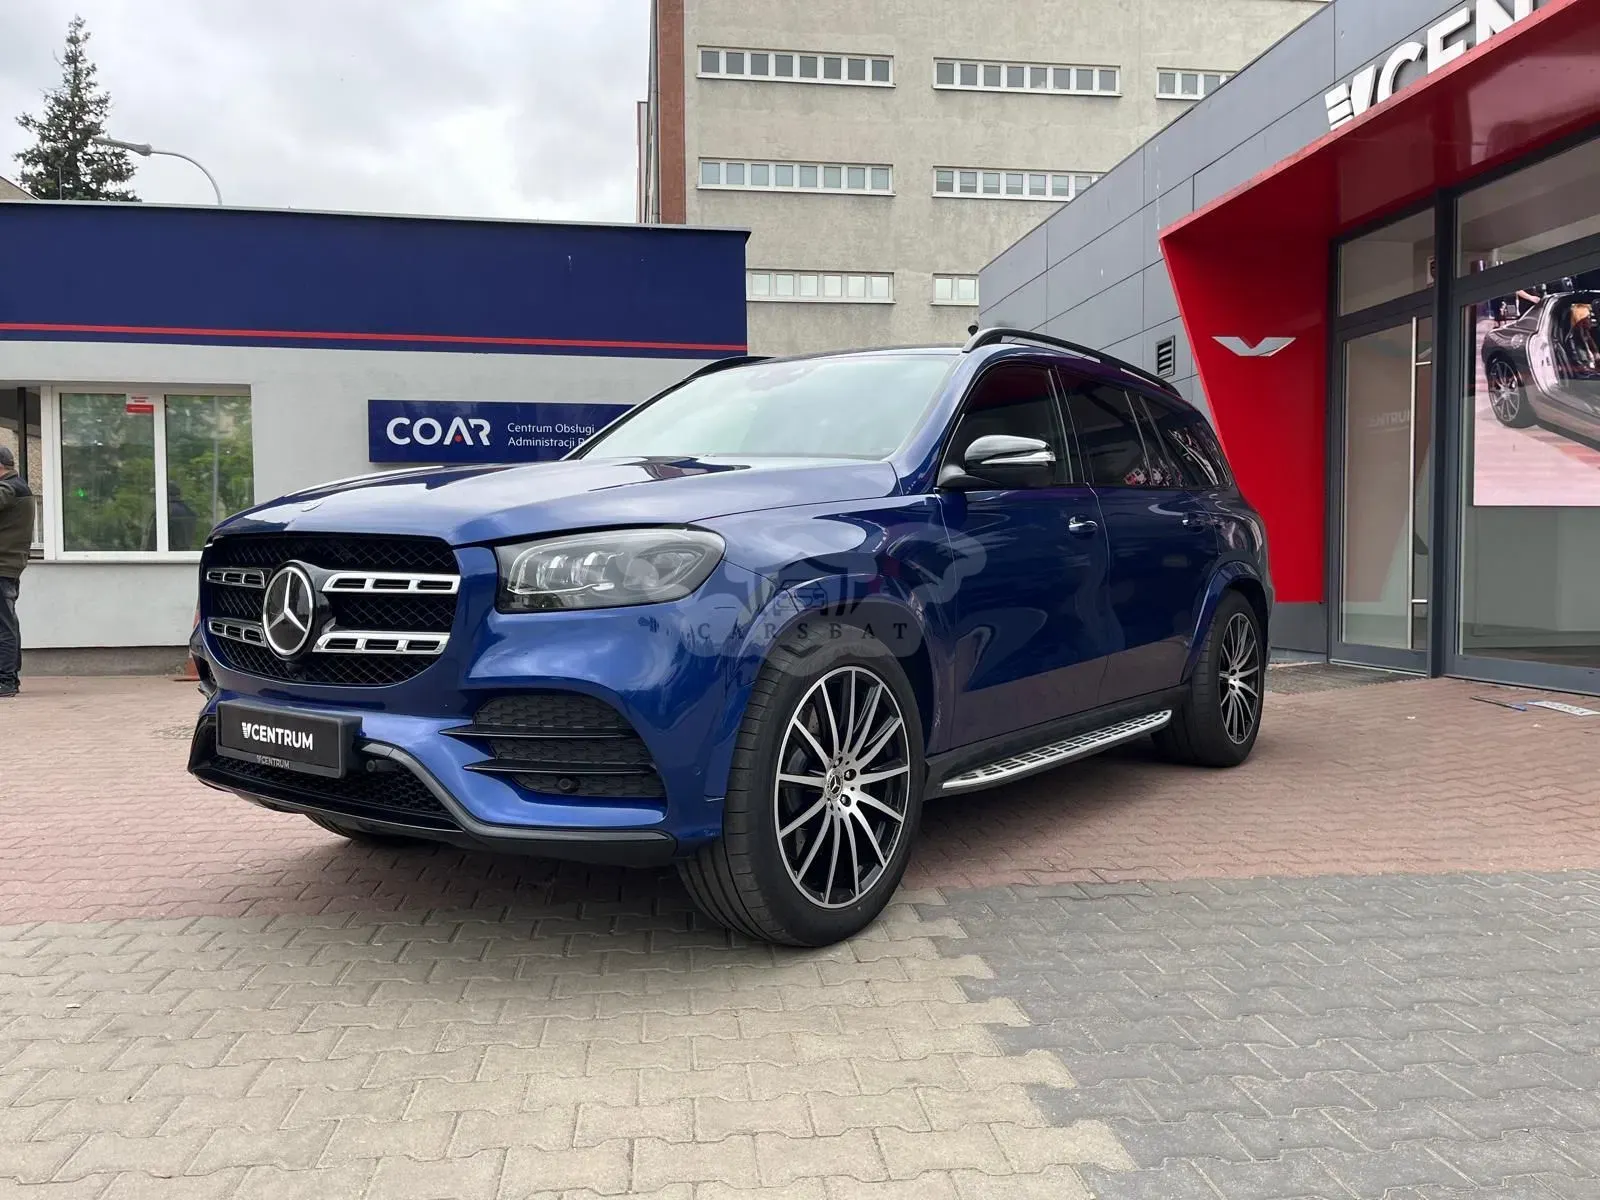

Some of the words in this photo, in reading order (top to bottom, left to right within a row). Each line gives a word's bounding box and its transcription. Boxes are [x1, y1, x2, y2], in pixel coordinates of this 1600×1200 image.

[386, 416, 491, 446] COAR
[507, 422, 552, 434] Centrum
[555, 423, 595, 436] Obsługi
[507, 437, 575, 449] Administracji
